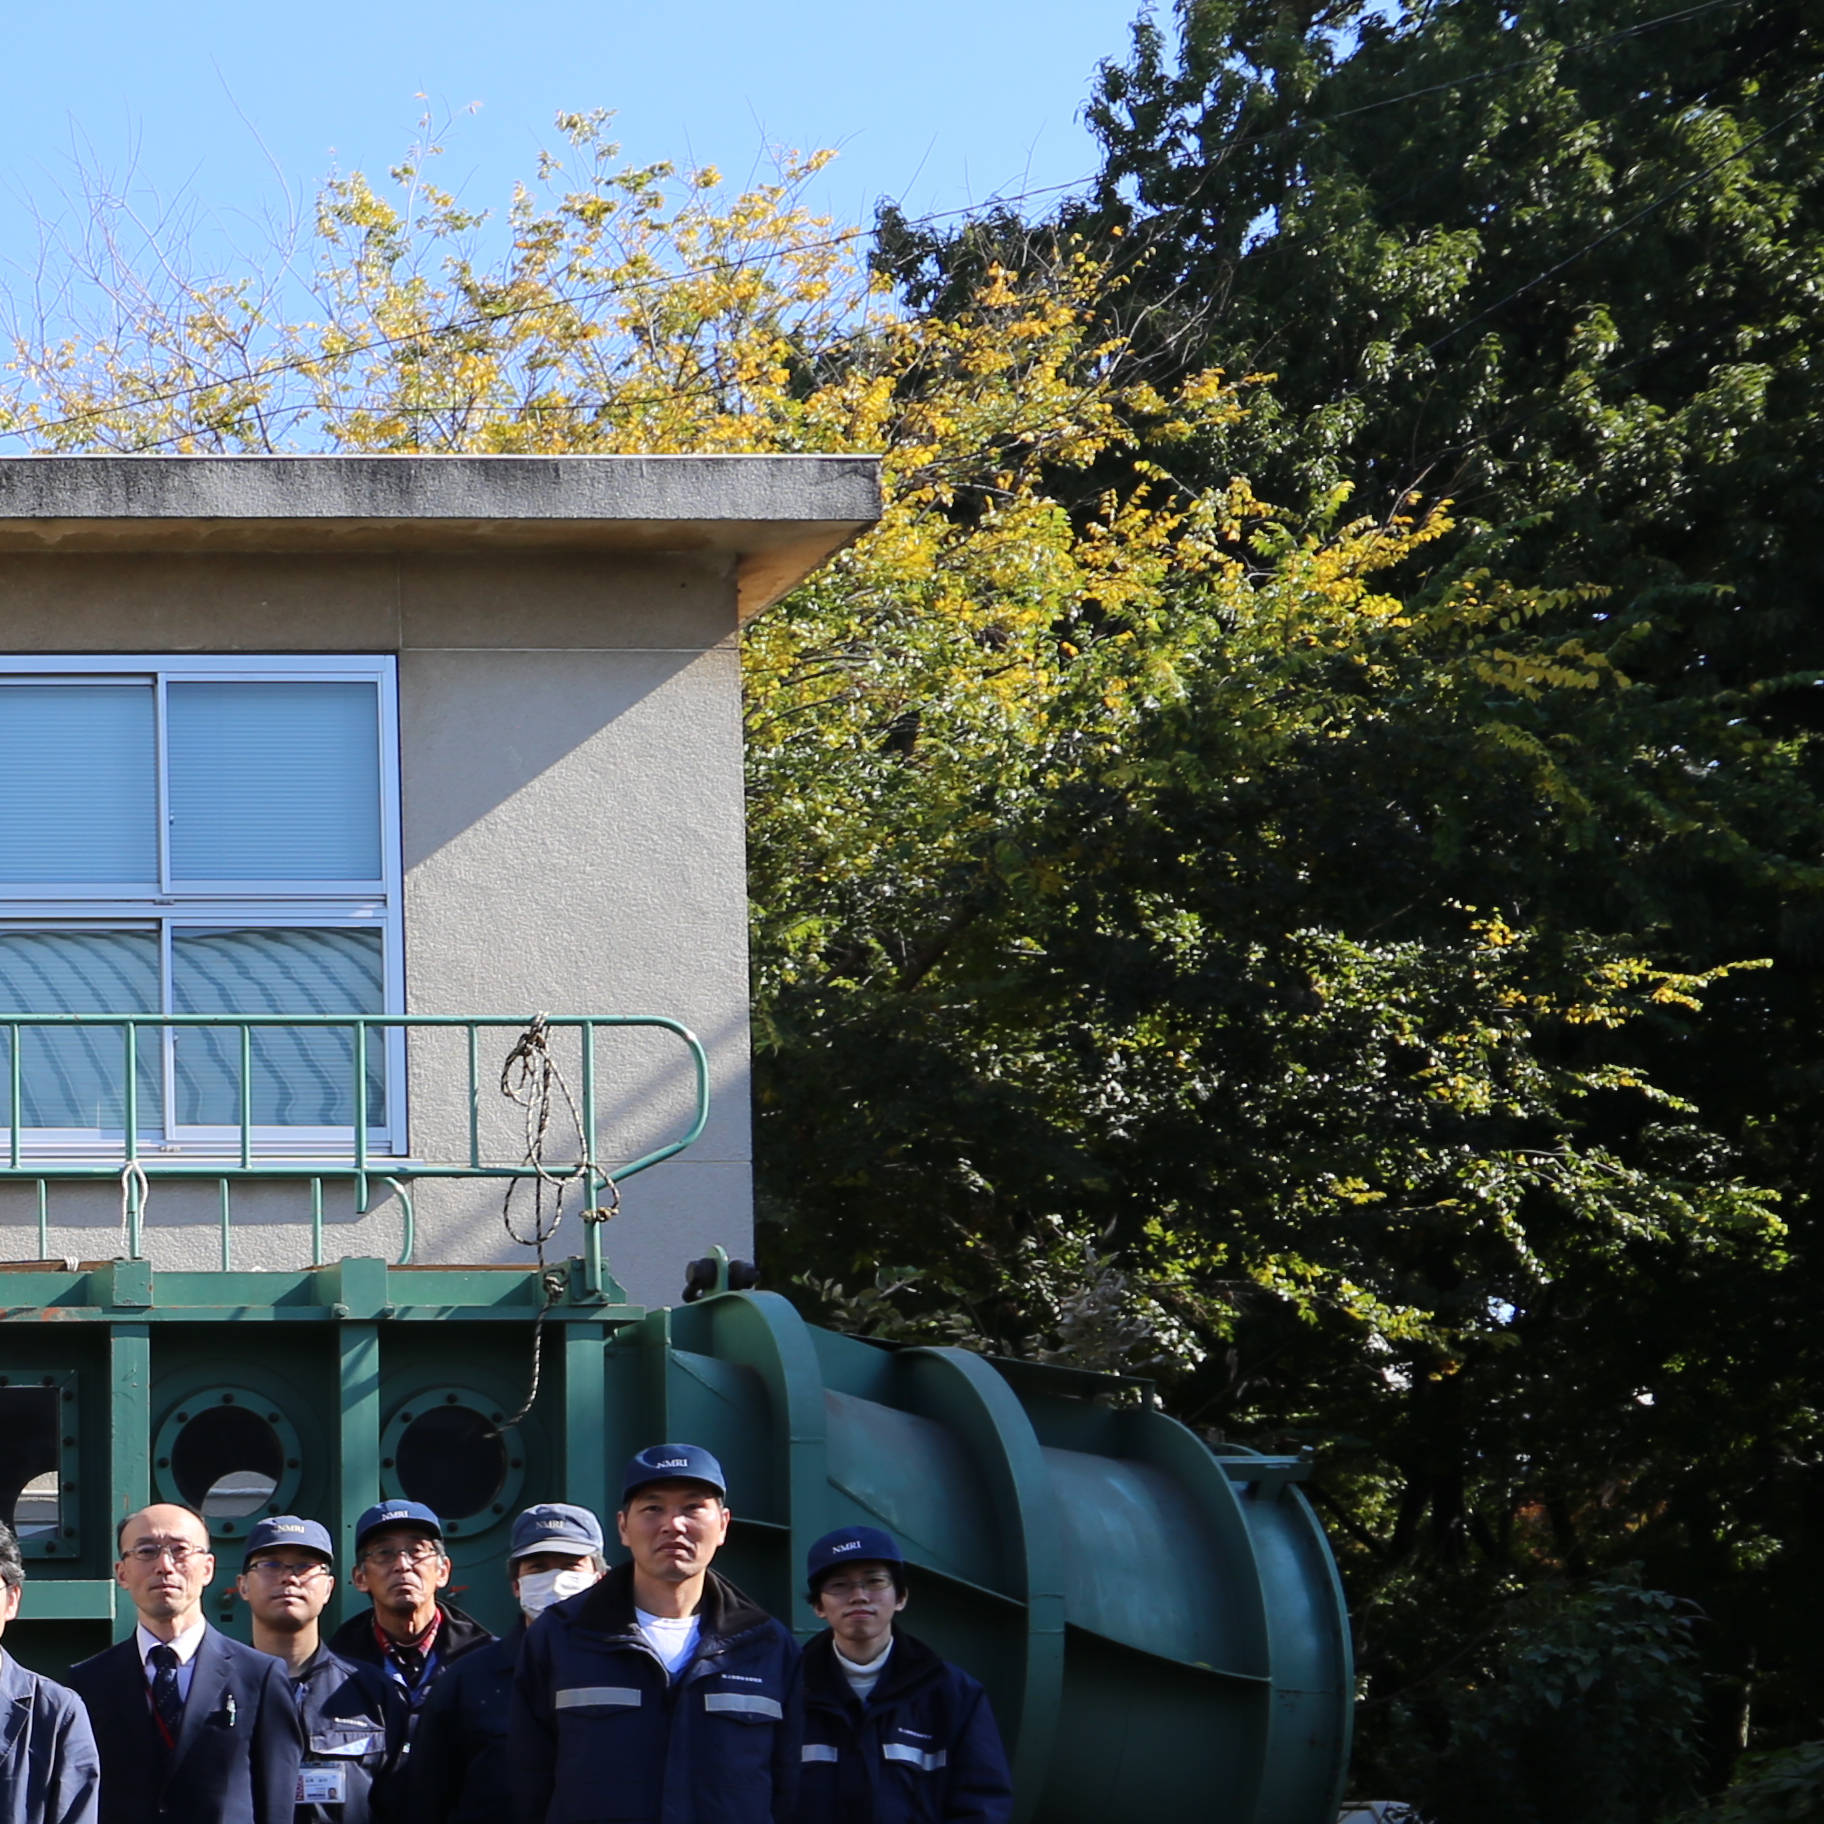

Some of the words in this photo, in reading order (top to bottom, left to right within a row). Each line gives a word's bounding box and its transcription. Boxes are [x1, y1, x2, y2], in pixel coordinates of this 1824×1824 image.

[656, 1459, 688, 1469] NMRI
[382, 1510, 409, 1521] NMRI
[277, 1524, 305, 1534] NMRI
[536, 1520, 564, 1530] NMRI
[832, 1540, 861, 1554] NMRI
